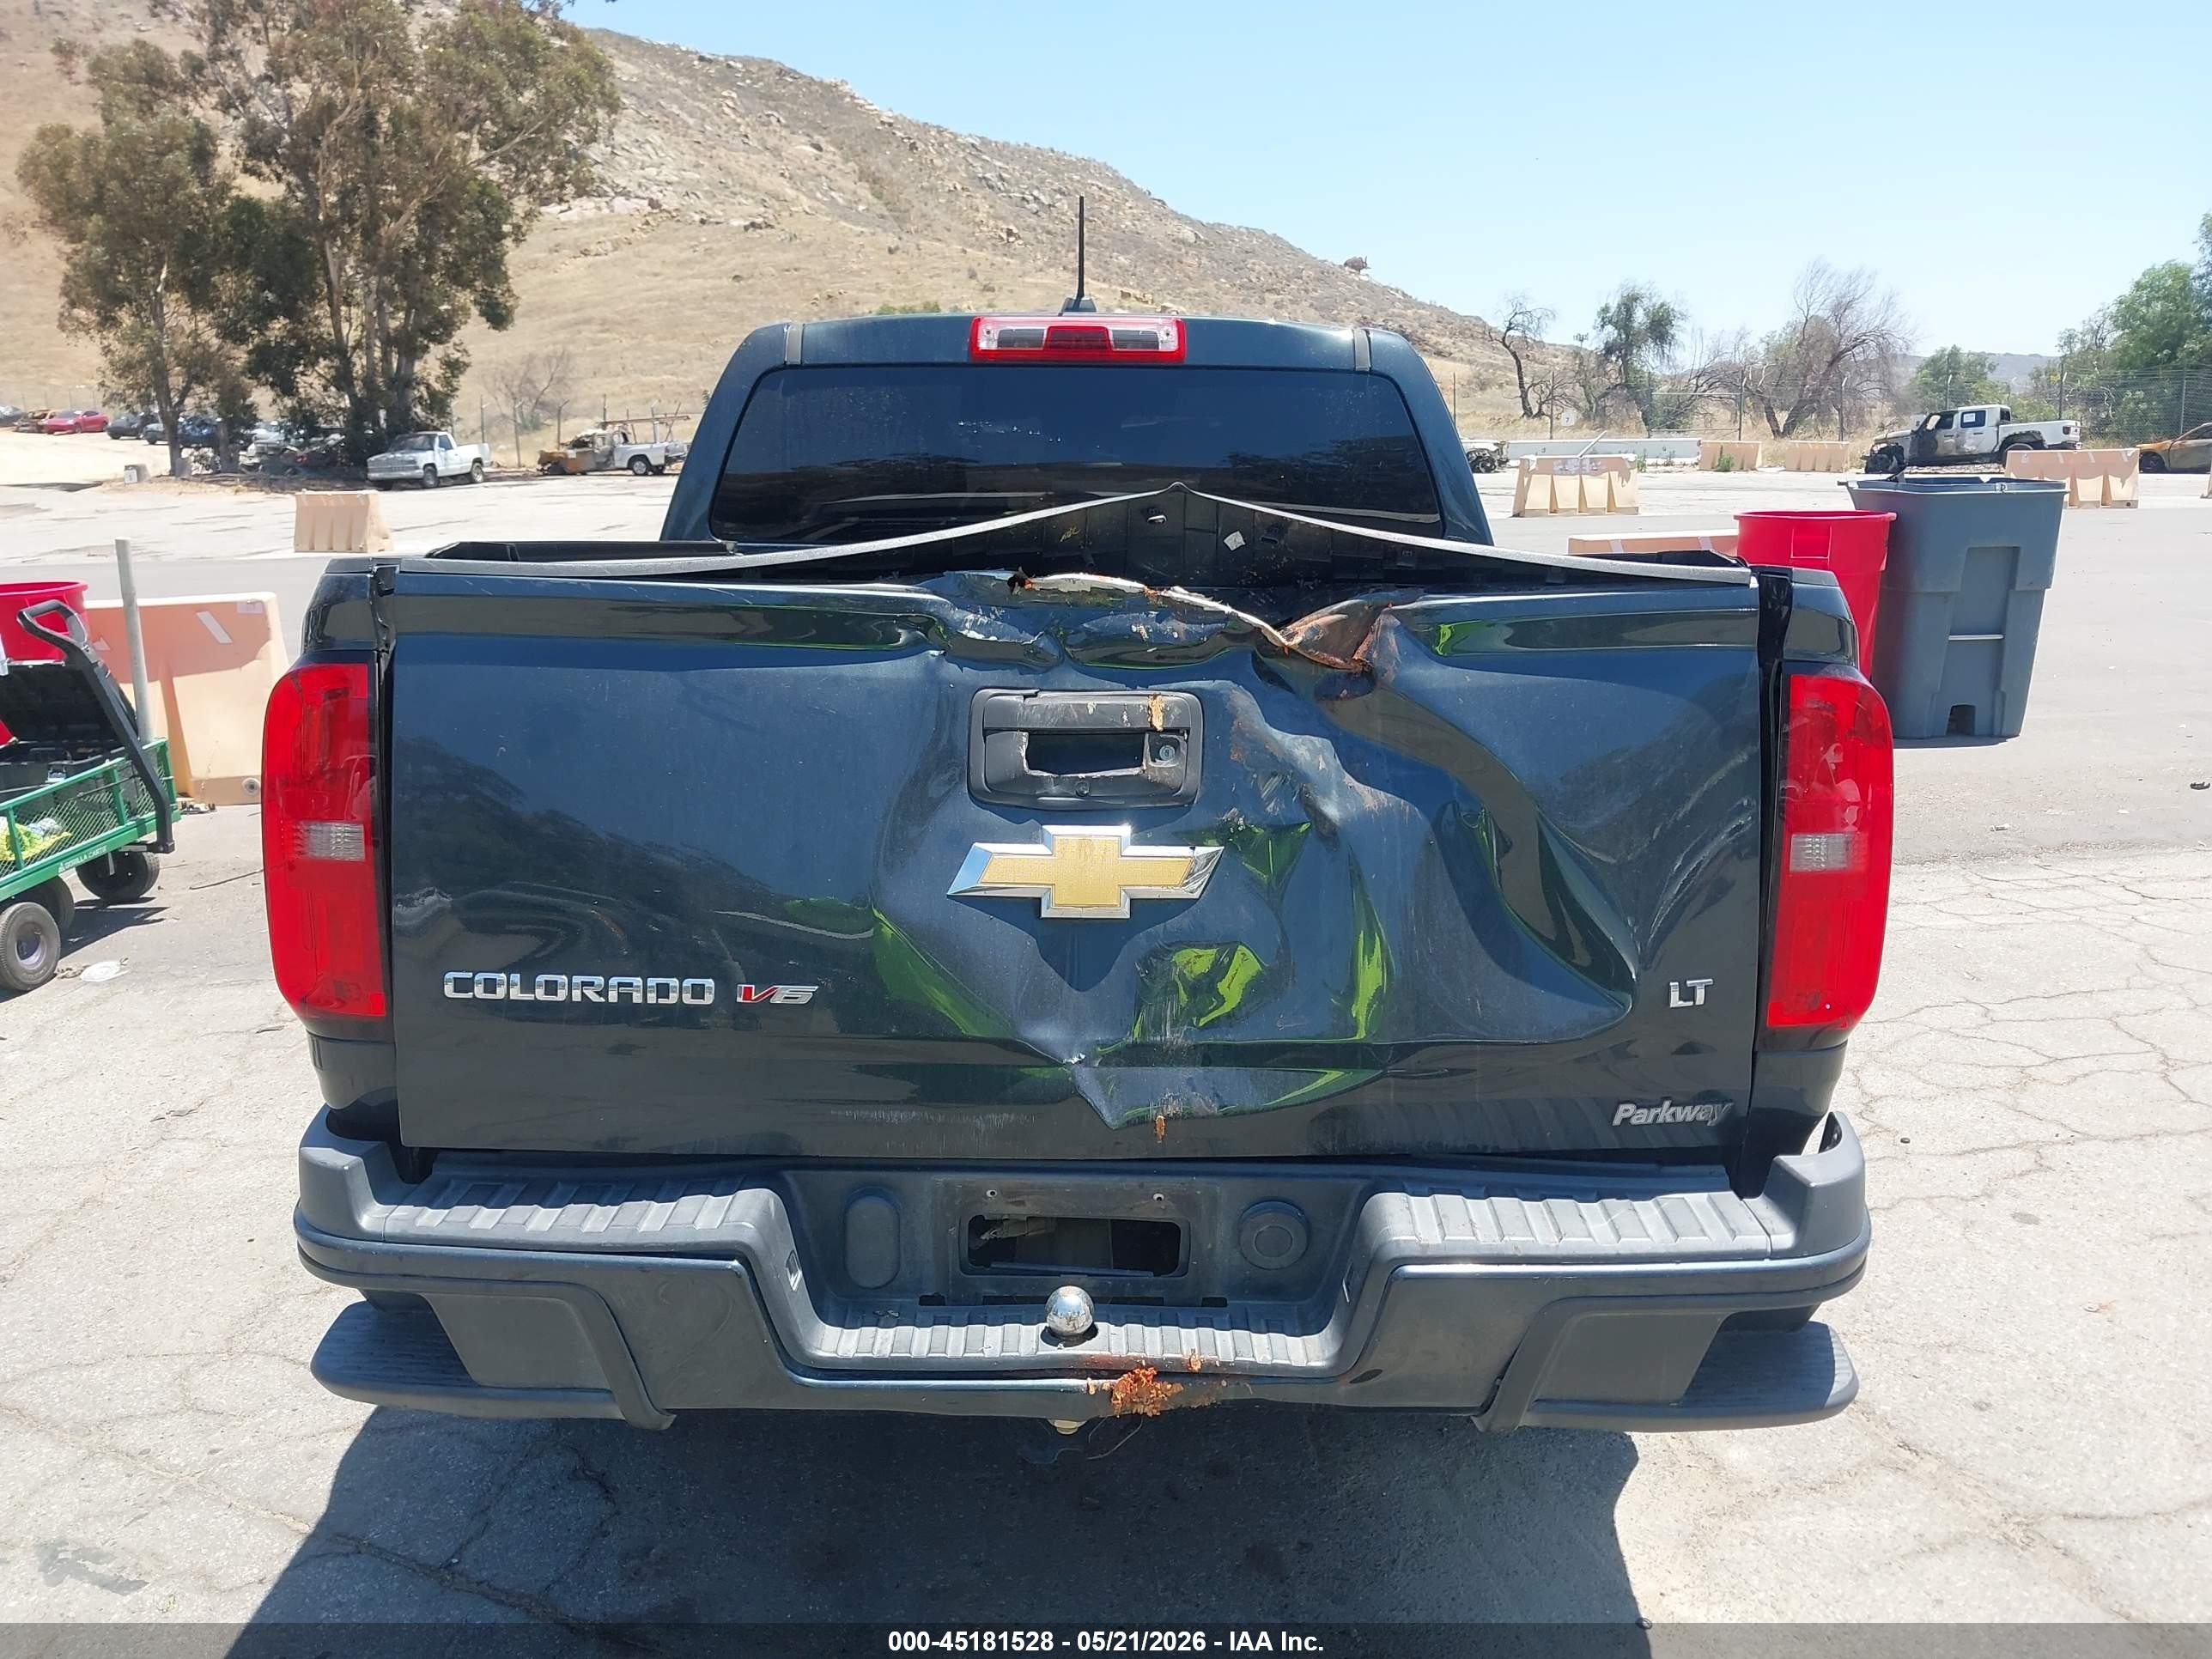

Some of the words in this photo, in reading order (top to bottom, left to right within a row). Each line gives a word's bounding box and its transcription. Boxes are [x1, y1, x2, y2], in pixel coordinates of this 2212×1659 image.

[443, 971, 714, 1006] COLORADO
[736, 983, 819, 1004] V6
[1669, 978, 1714, 1008] LT
[1611, 1099, 1734, 1127] Parkway
